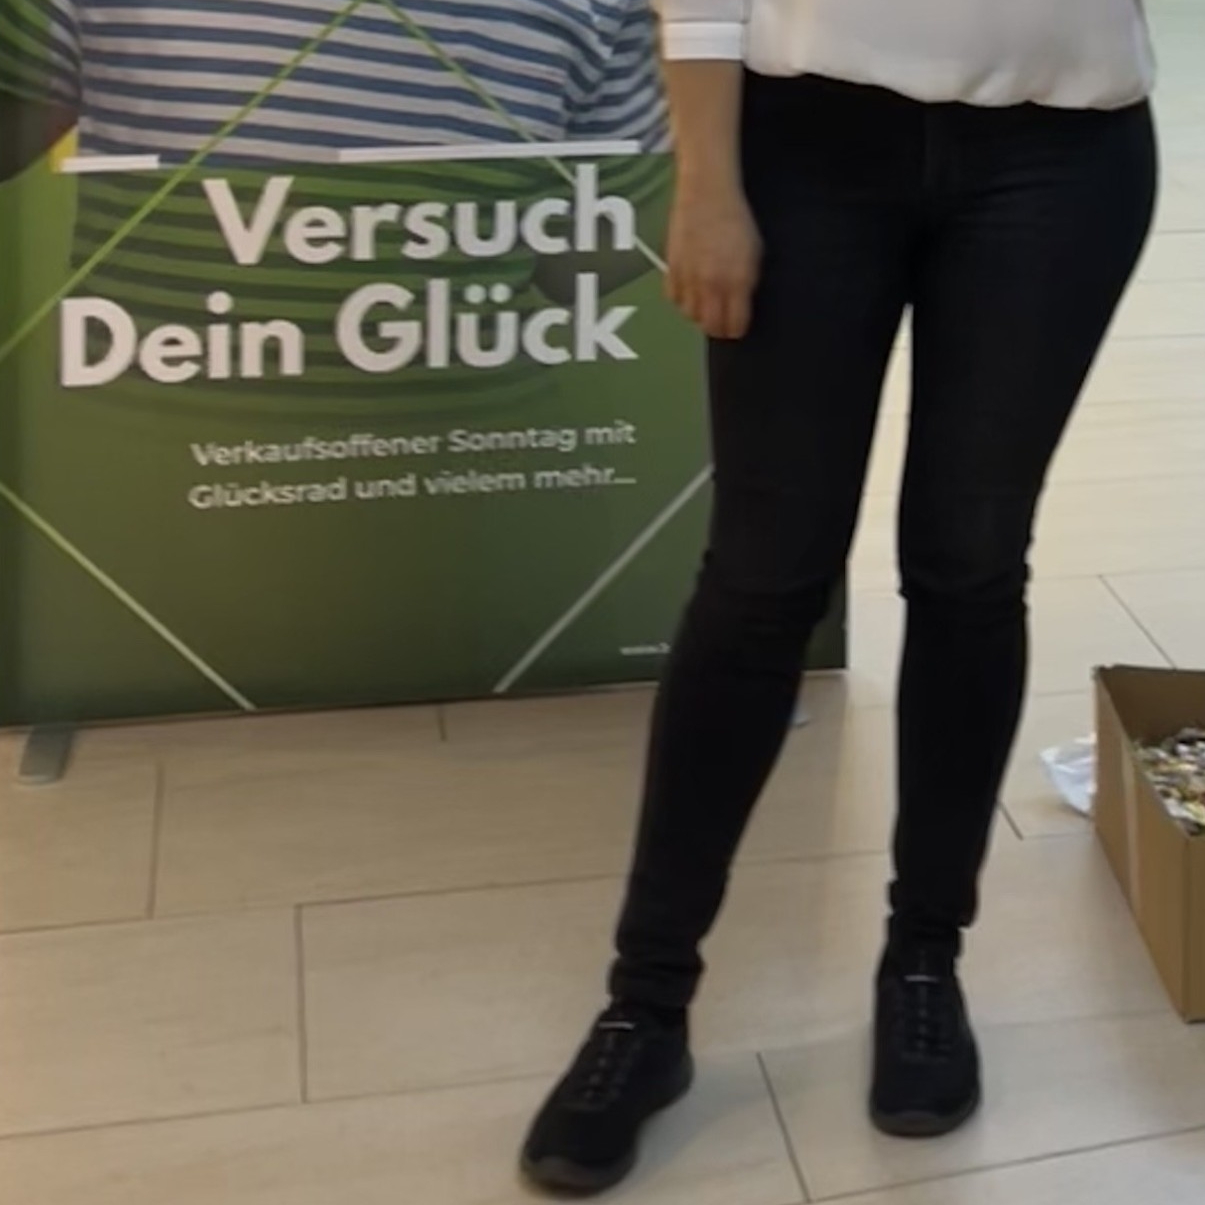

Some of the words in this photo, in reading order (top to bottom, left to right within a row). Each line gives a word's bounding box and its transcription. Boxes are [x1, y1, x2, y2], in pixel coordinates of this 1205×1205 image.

[201, 163, 637, 267] Versuch
[59, 291, 304, 388] Dein
[336, 273, 639, 374] Glück
[189, 433, 443, 466] Verkaufsoffener
[447, 427, 578, 453] Sonntag
[583, 419, 638, 445] mit
[187, 475, 348, 510] Glücksrad
[354, 472, 417, 500] und
[423, 469, 526, 495] vielem
